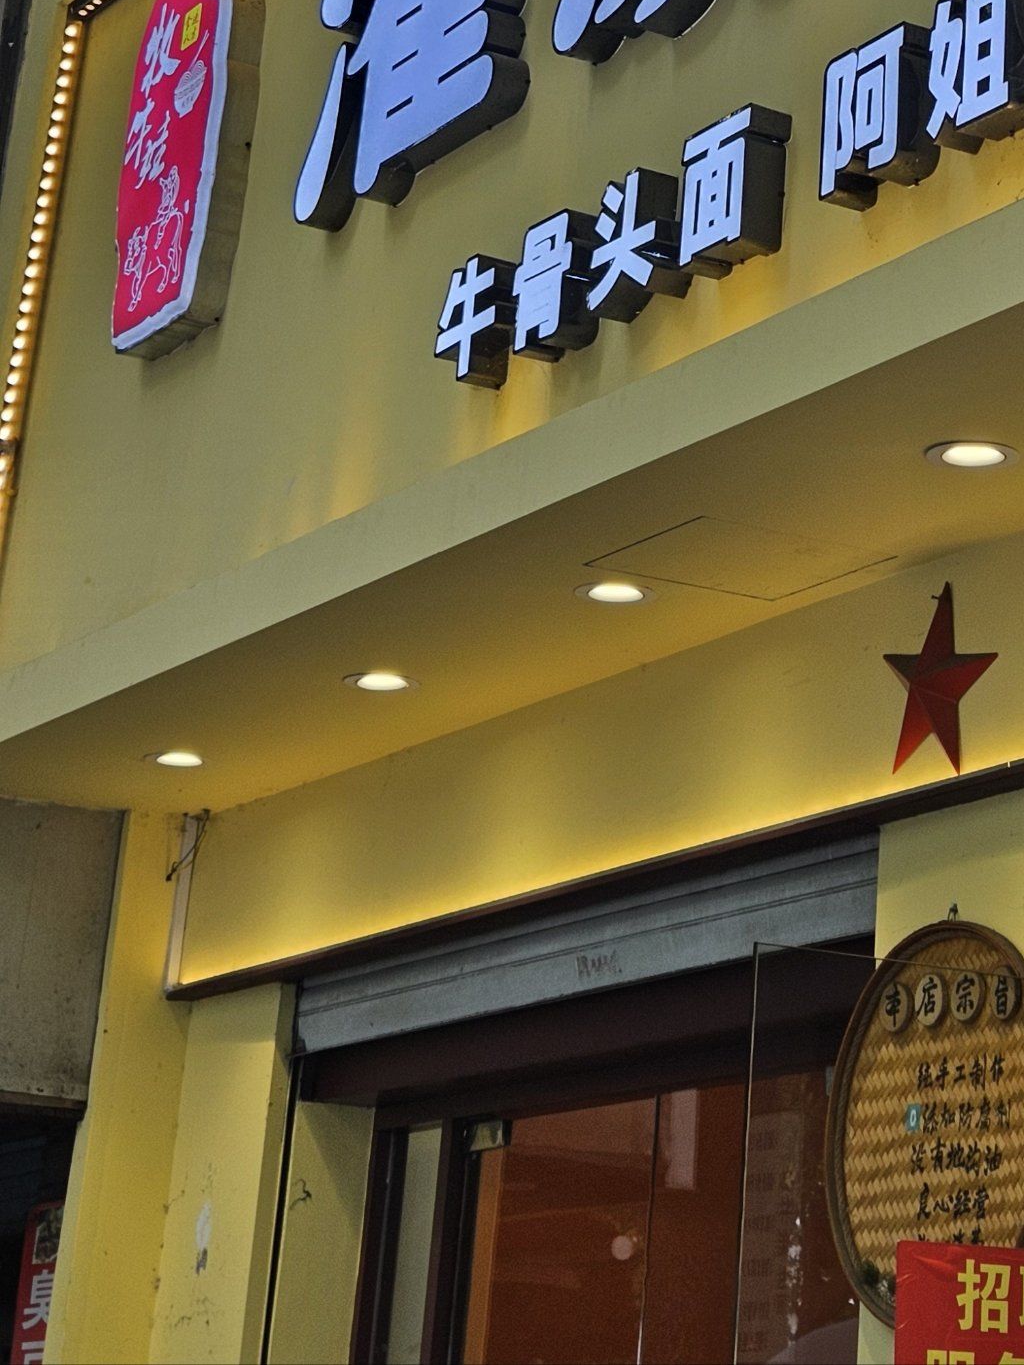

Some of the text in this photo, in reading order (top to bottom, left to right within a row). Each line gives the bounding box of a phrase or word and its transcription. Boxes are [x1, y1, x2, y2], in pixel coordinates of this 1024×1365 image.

[435, 105, 753, 382] 牛骨头面
[917, 1182, 990, 1220] 良心经营
